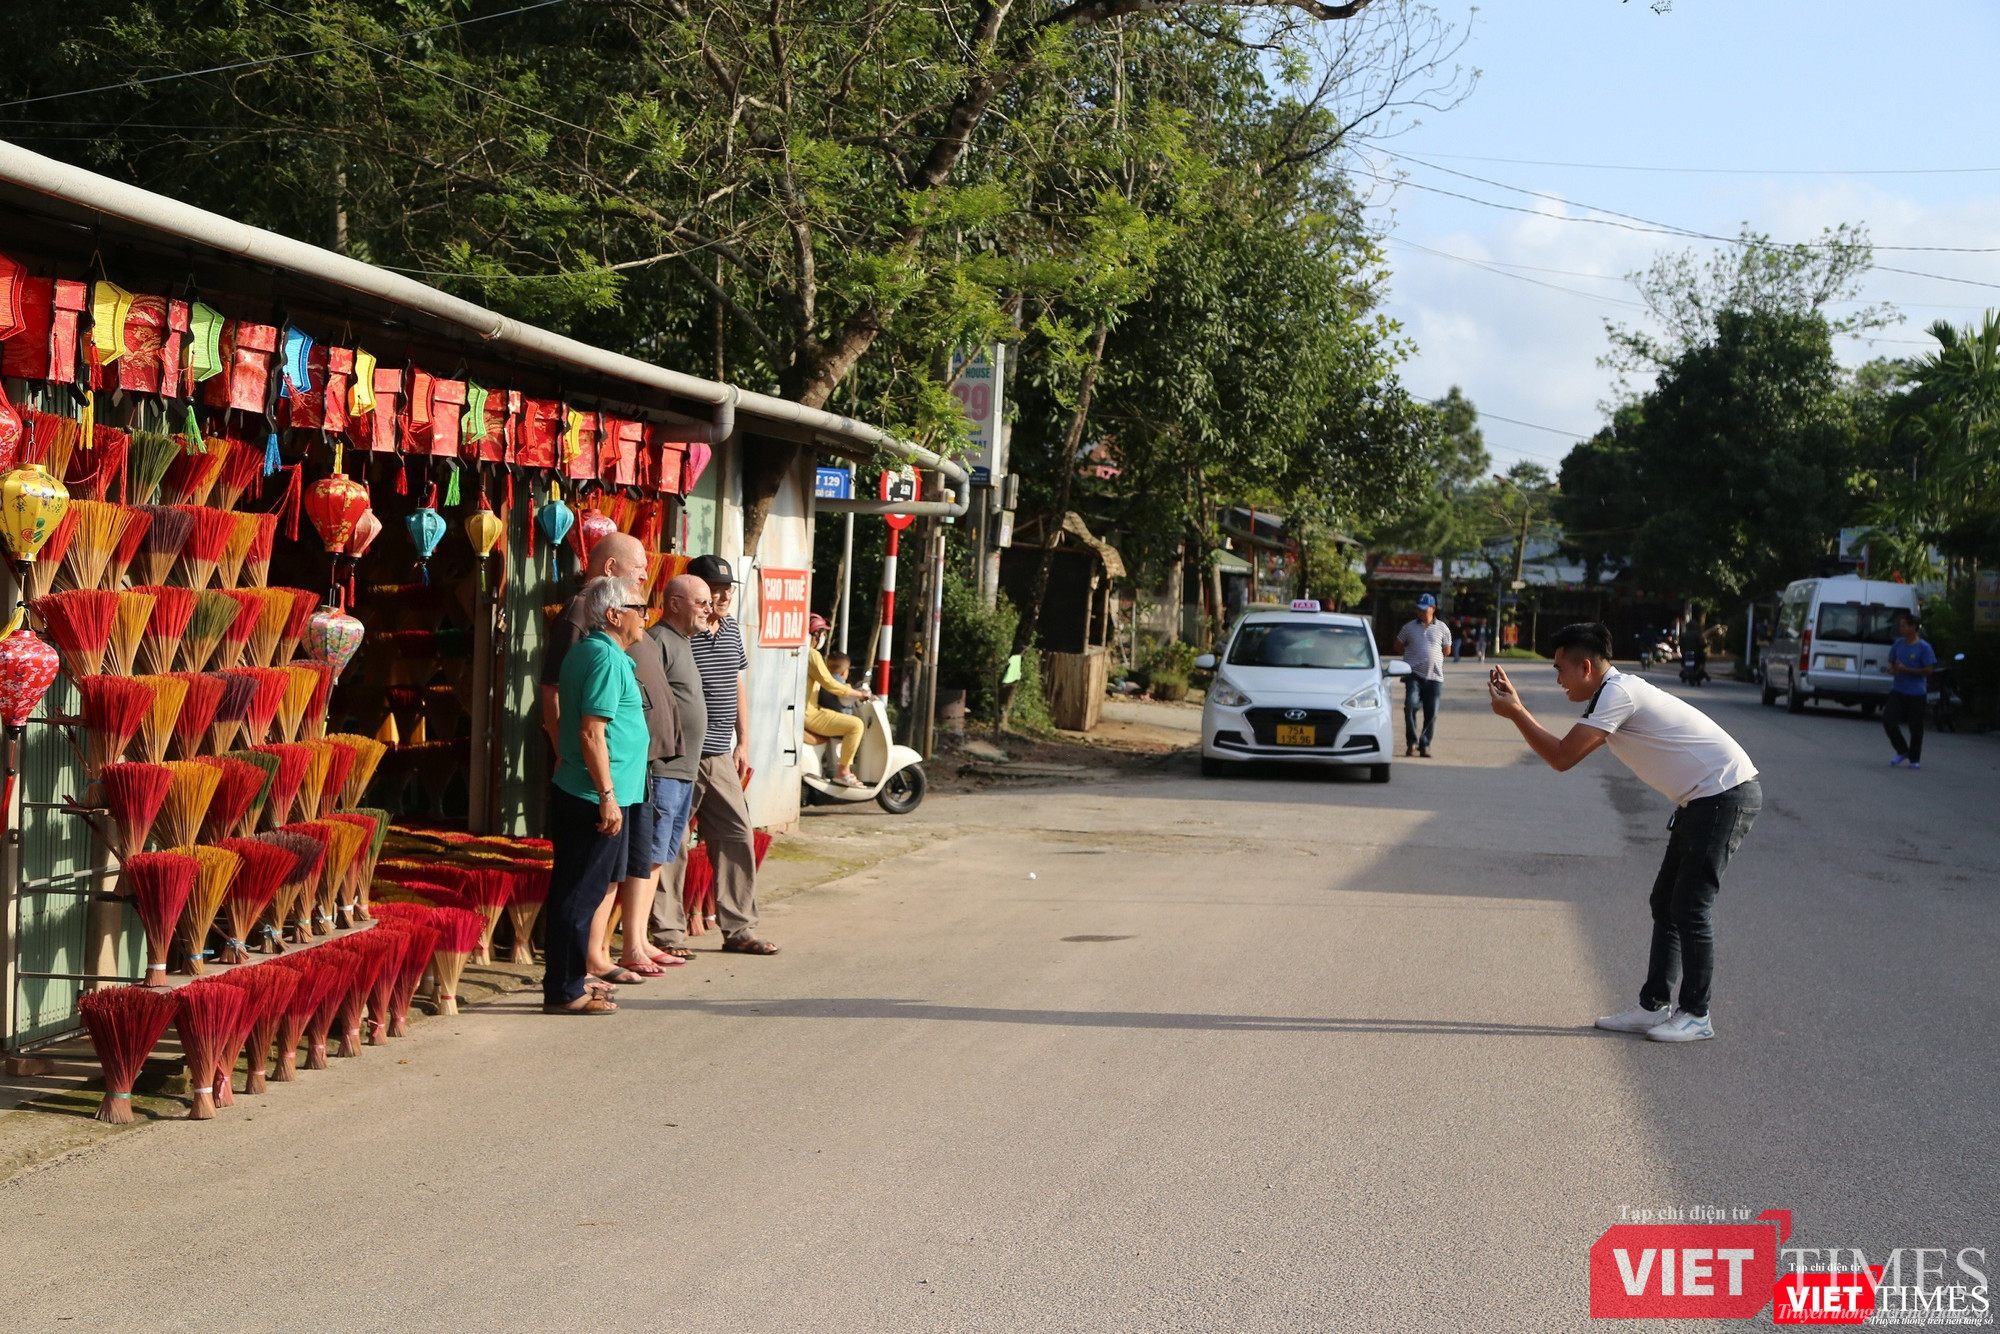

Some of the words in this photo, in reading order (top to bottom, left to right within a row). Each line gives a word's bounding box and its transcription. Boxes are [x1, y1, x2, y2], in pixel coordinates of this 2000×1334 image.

[965, 367, 991, 379] HOUSE
[953, 382, 991, 422] 29
[823, 475, 841, 488] 129
[764, 577, 783, 601] CHO
[784, 574, 806, 602] THUÊ
[1292, 601, 1317, 609] TAXI
[763, 605, 782, 639] ÁO
[782, 605, 804, 639] DÀI
[1287, 726, 1304, 735] 75A
